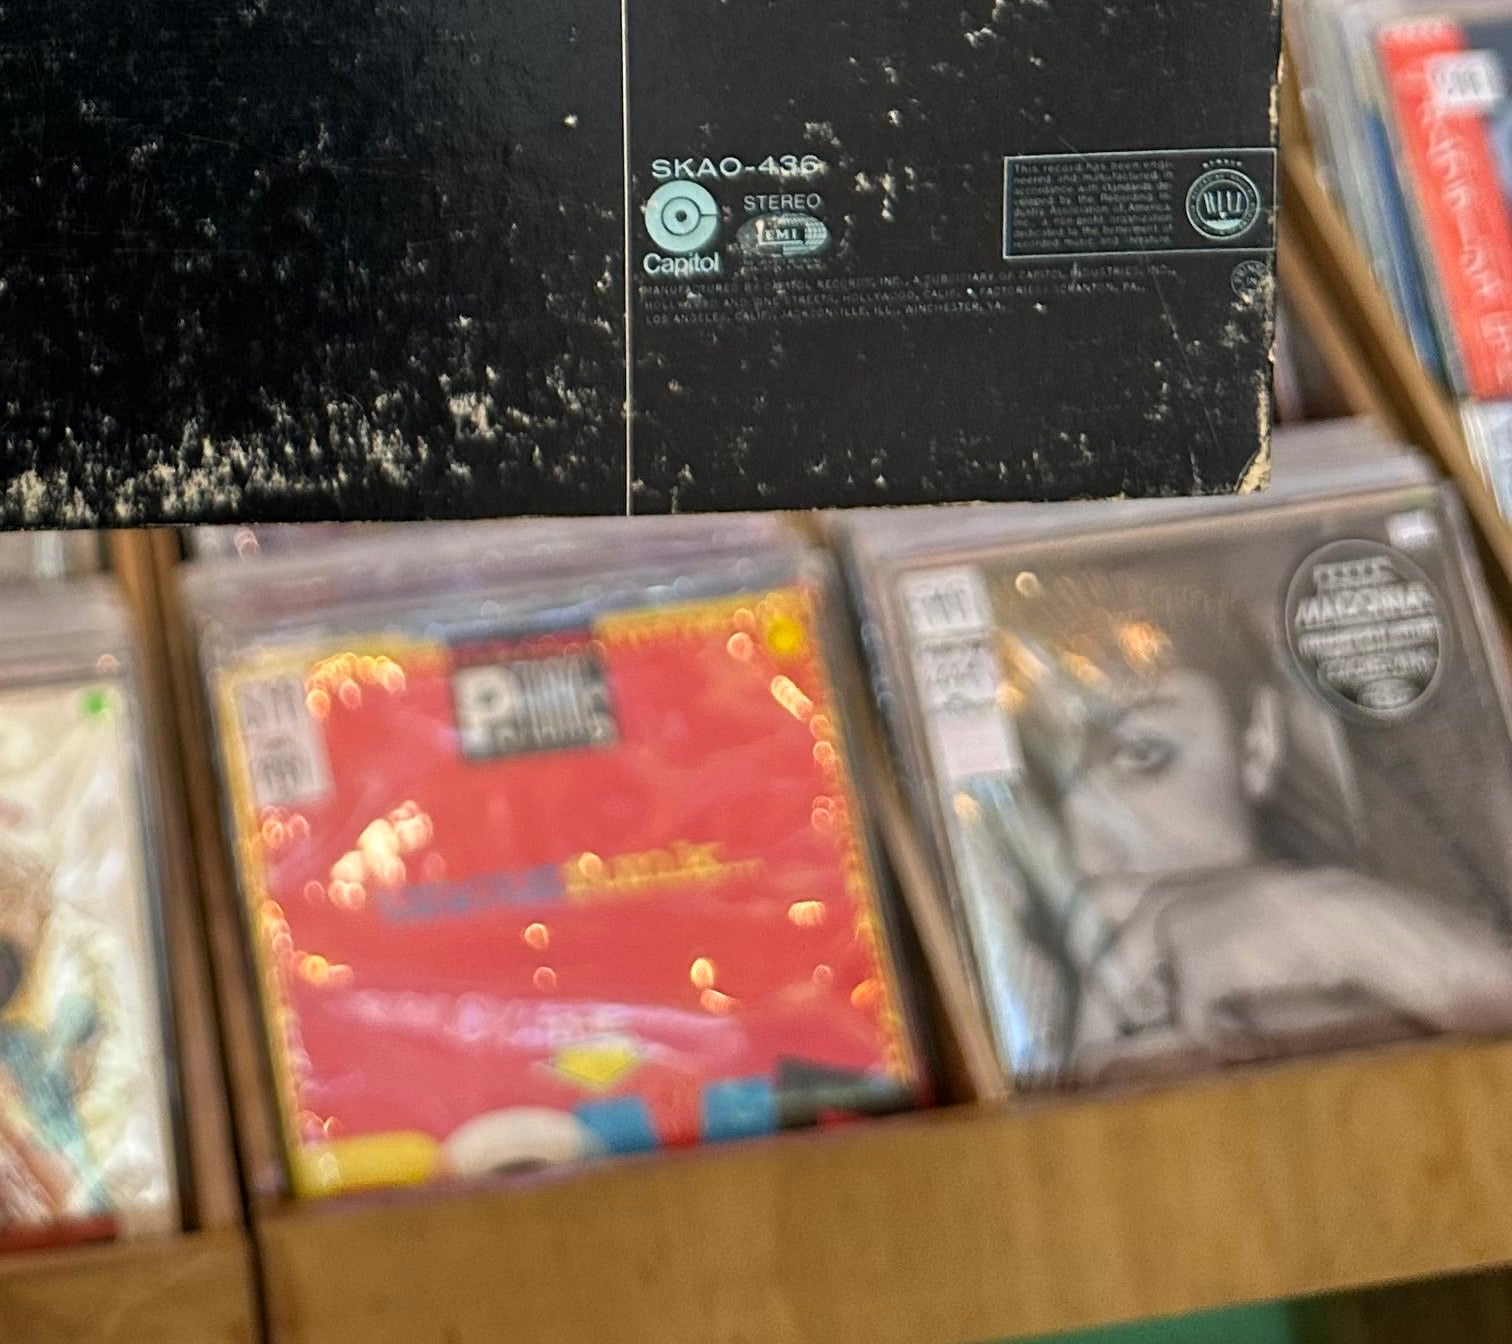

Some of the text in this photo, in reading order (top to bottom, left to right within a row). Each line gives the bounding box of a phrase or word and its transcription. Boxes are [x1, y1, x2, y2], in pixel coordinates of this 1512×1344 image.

[651, 155, 822, 179] SKAO-436
[743, 193, 822, 212] STEREO
[764, 228, 799, 242] EMI
[643, 252, 720, 277] Capitol
